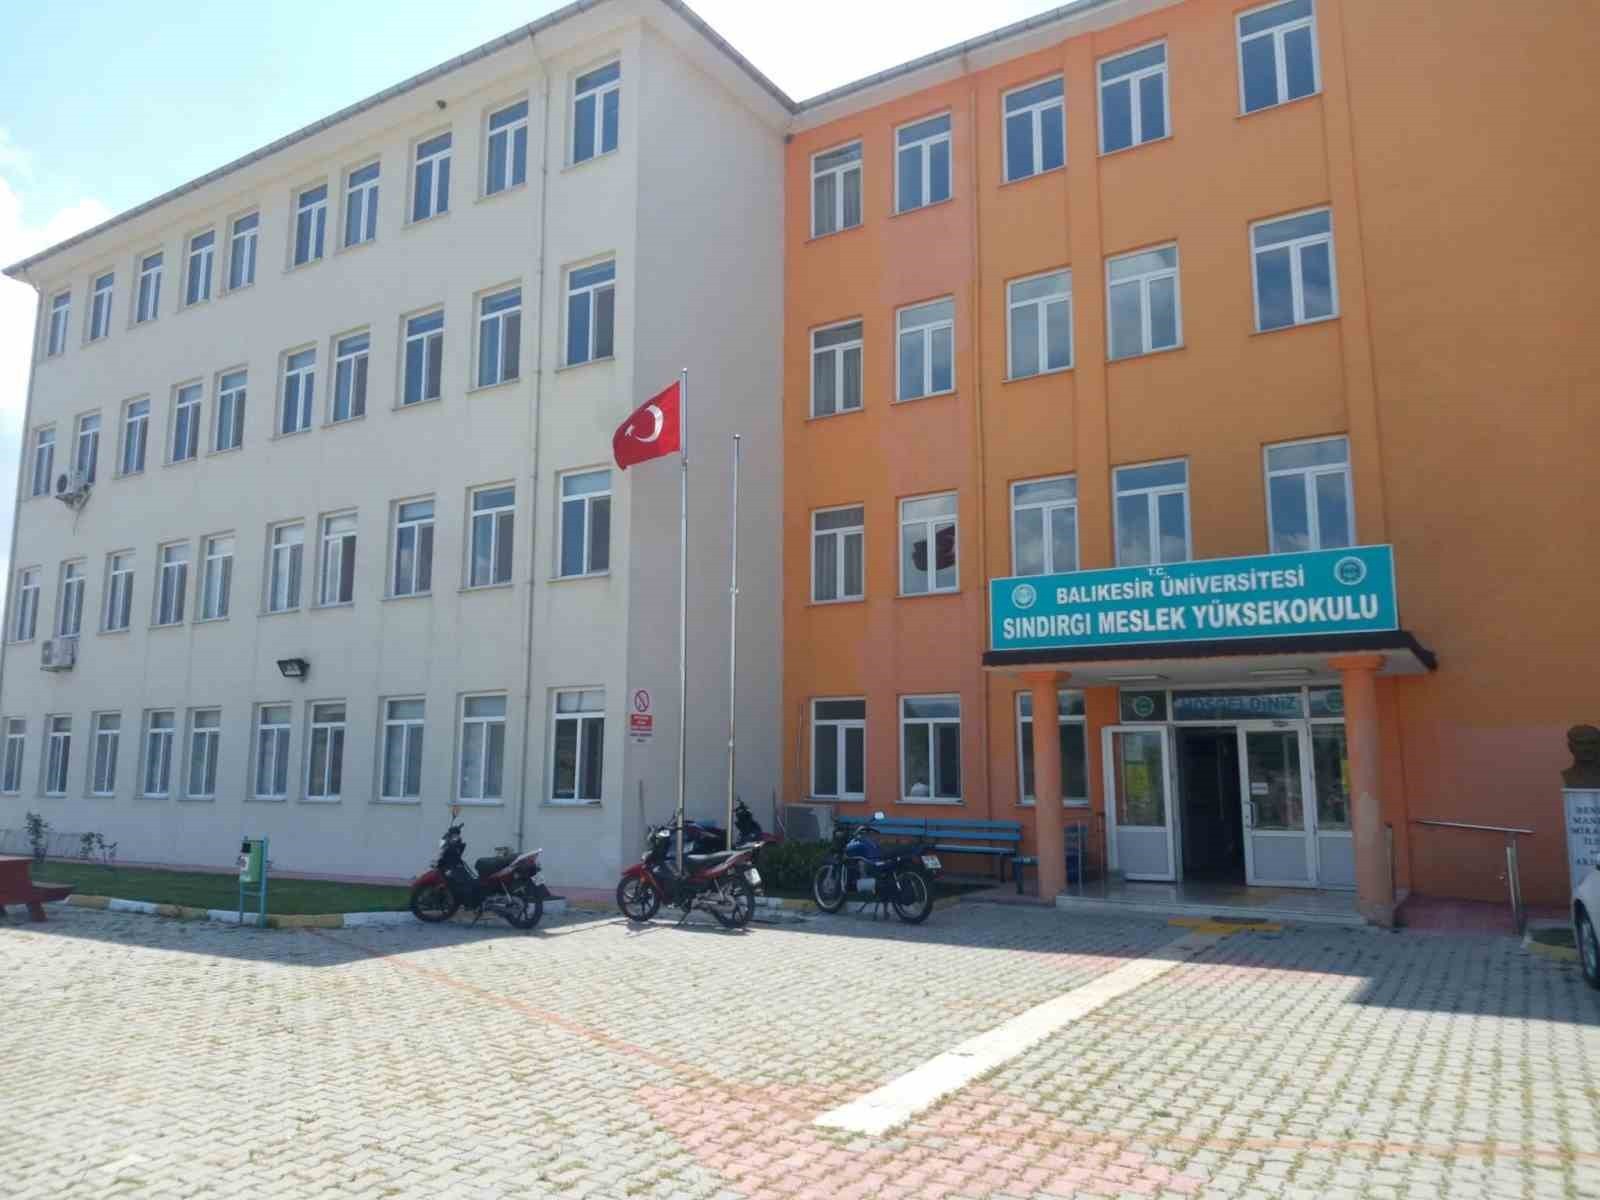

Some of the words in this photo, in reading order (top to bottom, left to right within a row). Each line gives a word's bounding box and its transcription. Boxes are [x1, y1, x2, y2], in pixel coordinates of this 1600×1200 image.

[1056, 577, 1154, 604] BALIKESİR
[1160, 564, 1304, 597] ÜNİVERSİTESİ
[1003, 613, 1091, 640] SINDIRGI
[1098, 606, 1186, 633] MESLEK
[1192, 593, 1378, 629] YÜKSEKOKULU
